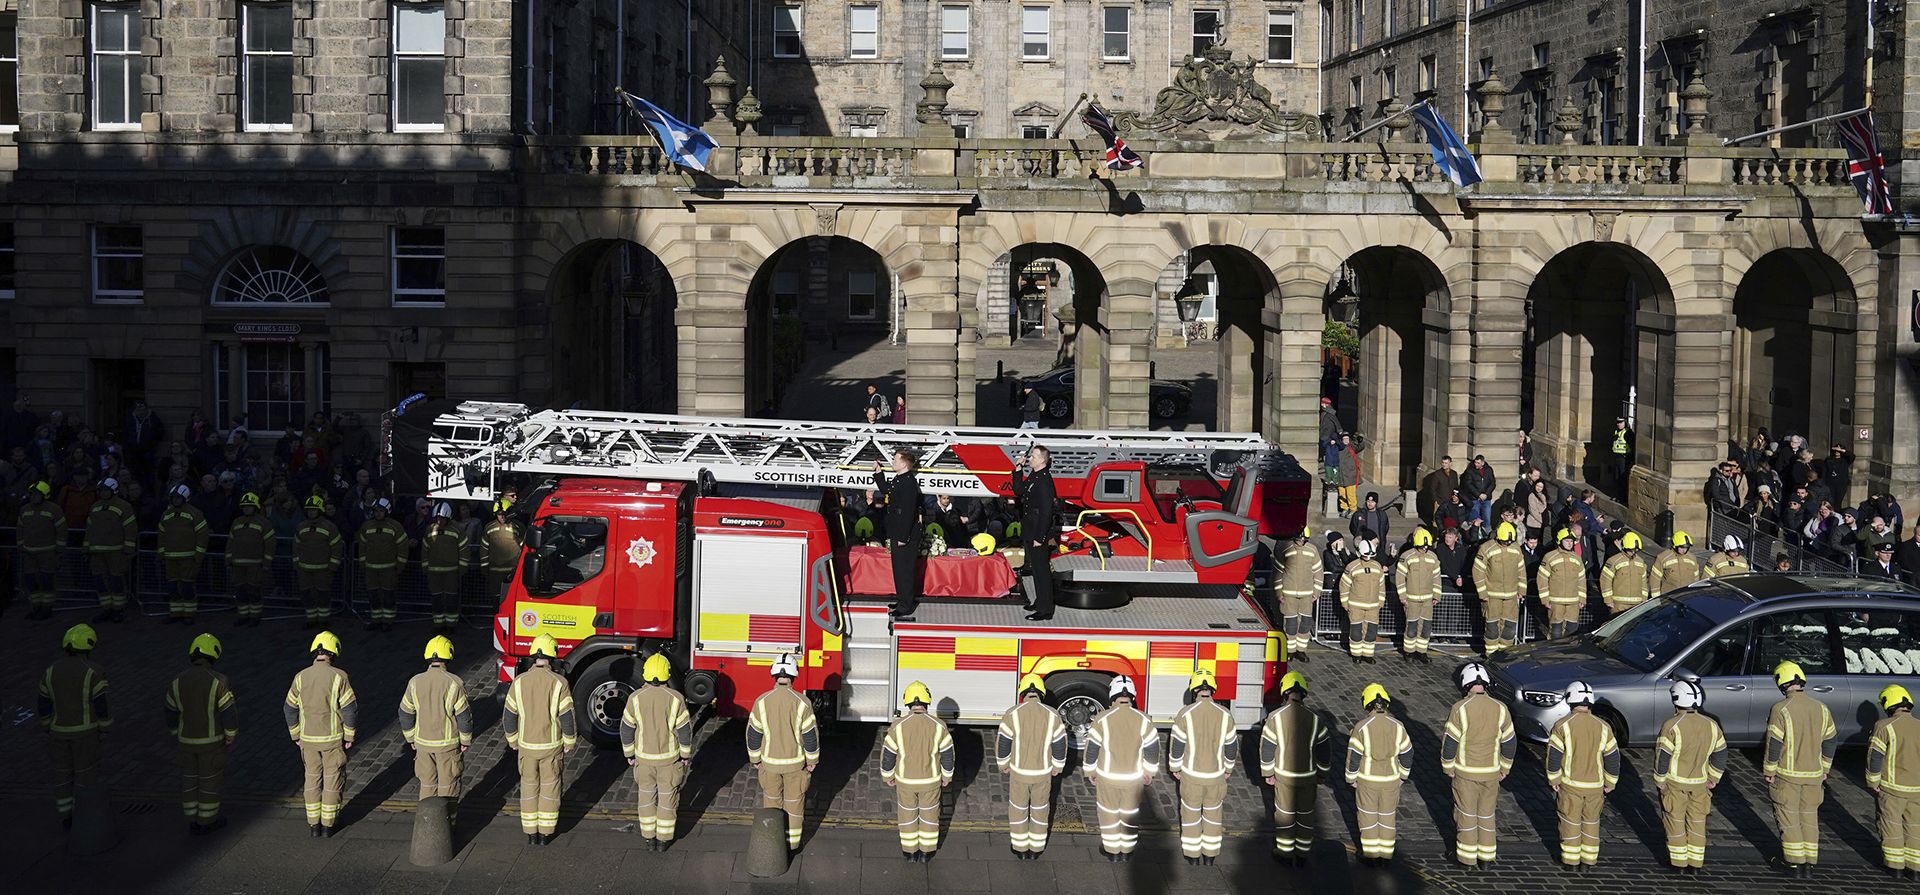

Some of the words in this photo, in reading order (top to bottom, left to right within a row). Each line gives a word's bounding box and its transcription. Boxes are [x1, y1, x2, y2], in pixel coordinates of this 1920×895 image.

[754, 471, 815, 483] SCOTTISH
[818, 474, 844, 484] FIRE
[846, 475, 875, 485] AND
[929, 478, 980, 489] SERVICE
[541, 613, 577, 621] SCOTTISH
